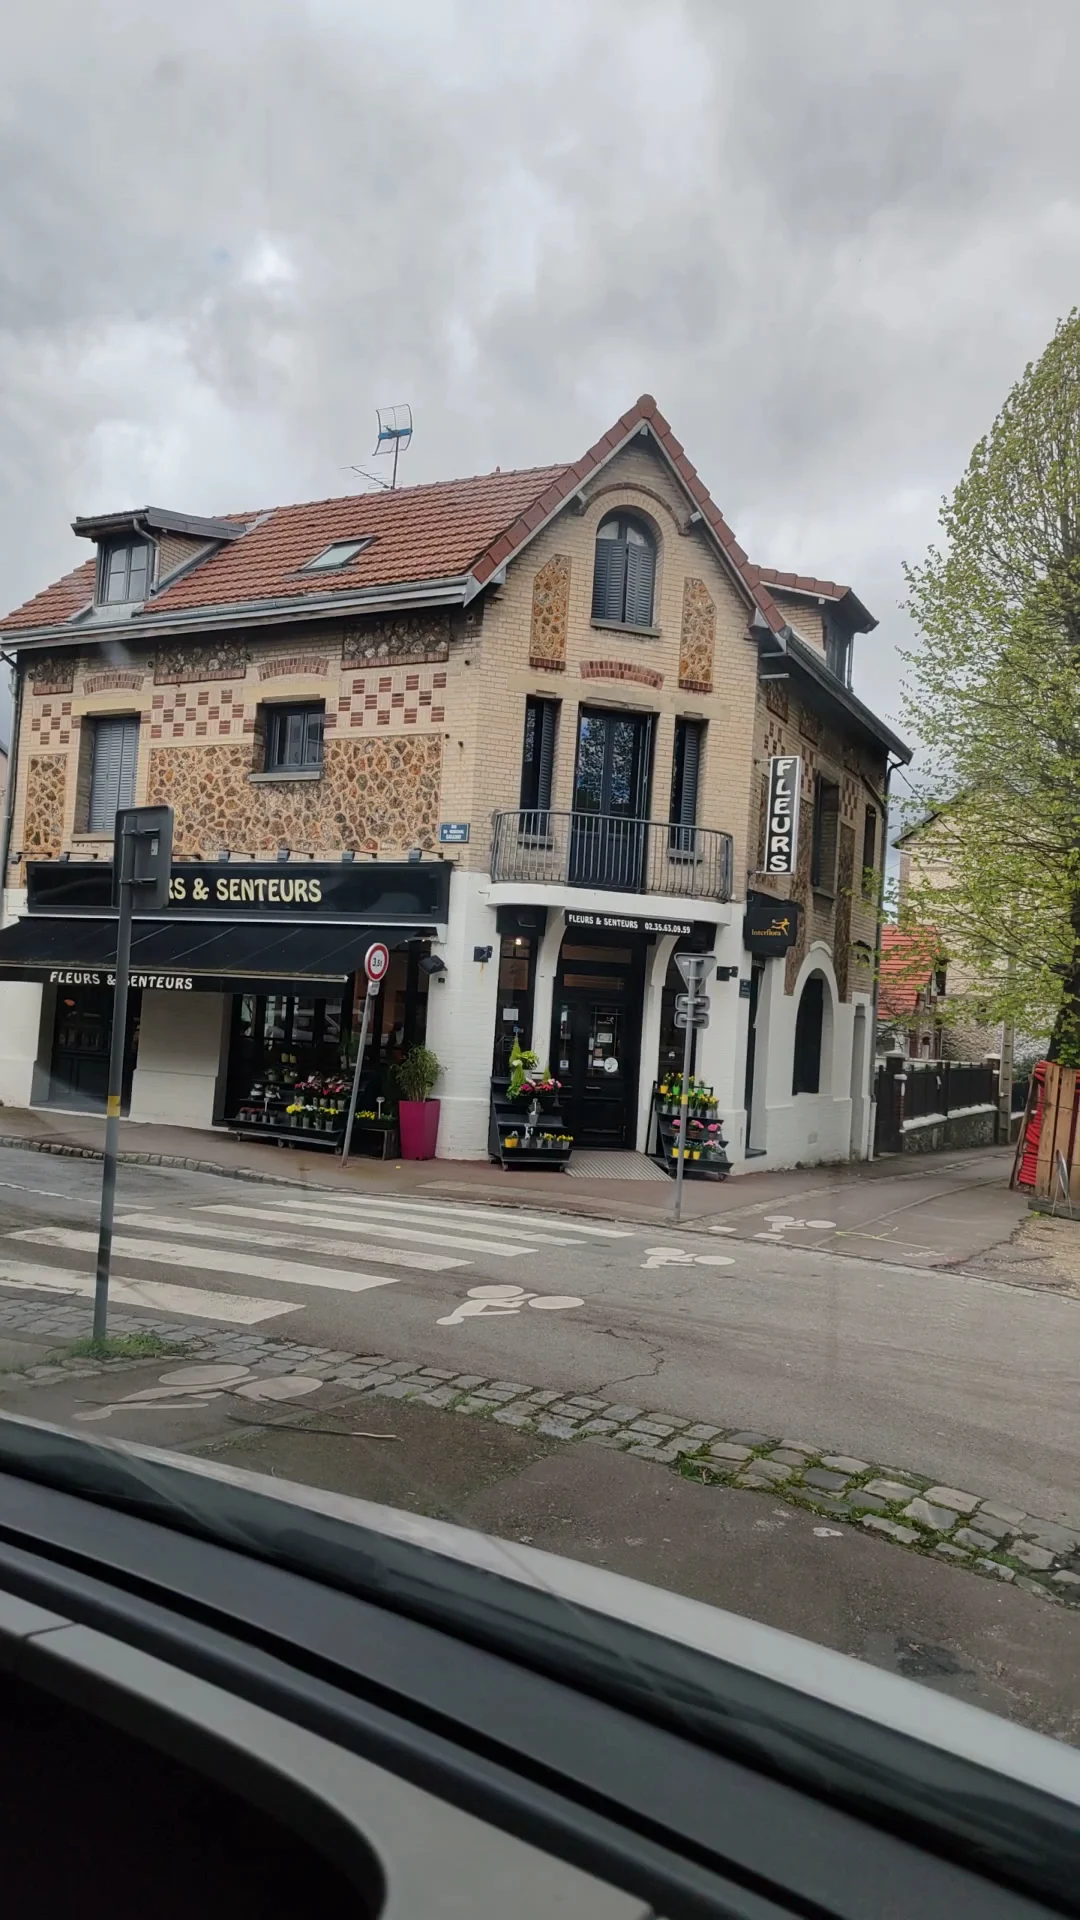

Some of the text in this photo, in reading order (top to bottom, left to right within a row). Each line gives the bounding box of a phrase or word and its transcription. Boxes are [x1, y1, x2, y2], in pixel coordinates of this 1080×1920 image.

[769, 759, 795, 872] FLEURS
[192, 877, 210, 901] &
[216, 878, 322, 903] SENTEURS
[568, 914, 593, 925] FLEURS
[596, 917, 602, 925] &
[603, 918, 638, 929] SENTEURS
[49, 971, 101, 985] FLEURS
[106, 974, 116, 986] &
